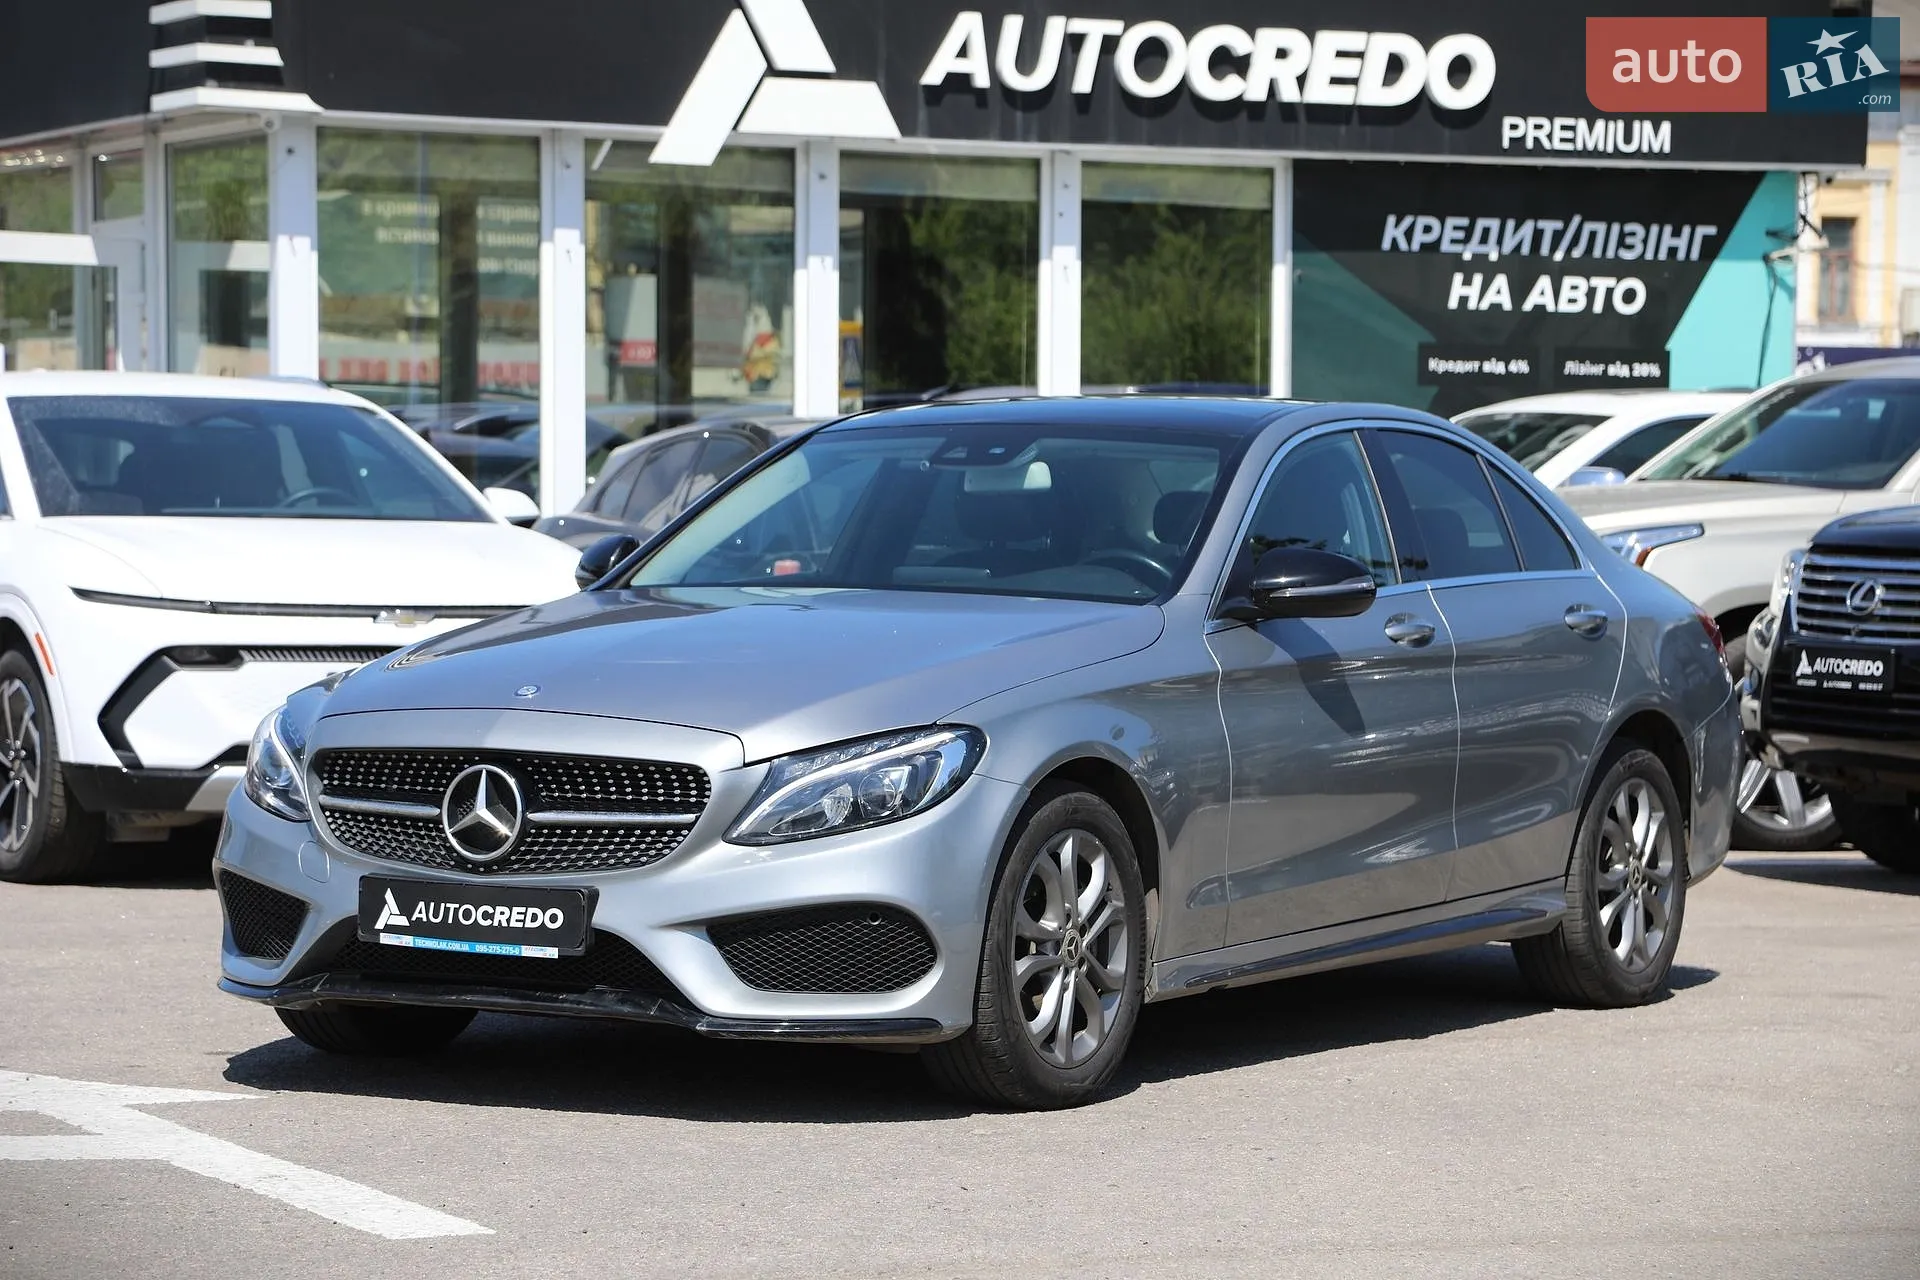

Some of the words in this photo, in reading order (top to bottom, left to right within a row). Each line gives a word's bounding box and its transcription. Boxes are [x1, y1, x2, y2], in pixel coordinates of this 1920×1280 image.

[919, 11, 1496, 110] AUTOCREDO
[1501, 115, 1672, 154] PREMIUM
[1381, 214, 1718, 262] КРЕДИТ/ЛІЗІНГ
[1447, 271, 1513, 312] НА
[1521, 273, 1648, 316] АВТО
[1427, 356, 1481, 375] Кредит
[1482, 357, 1507, 376] від
[1507, 358, 1531, 375] 4%
[1563, 360, 1606, 377] Лізінг
[1606, 360, 1631, 378] від
[1812, 656, 1884, 677] AUTOCREDO
[411, 900, 564, 930] AUTOCREDO
